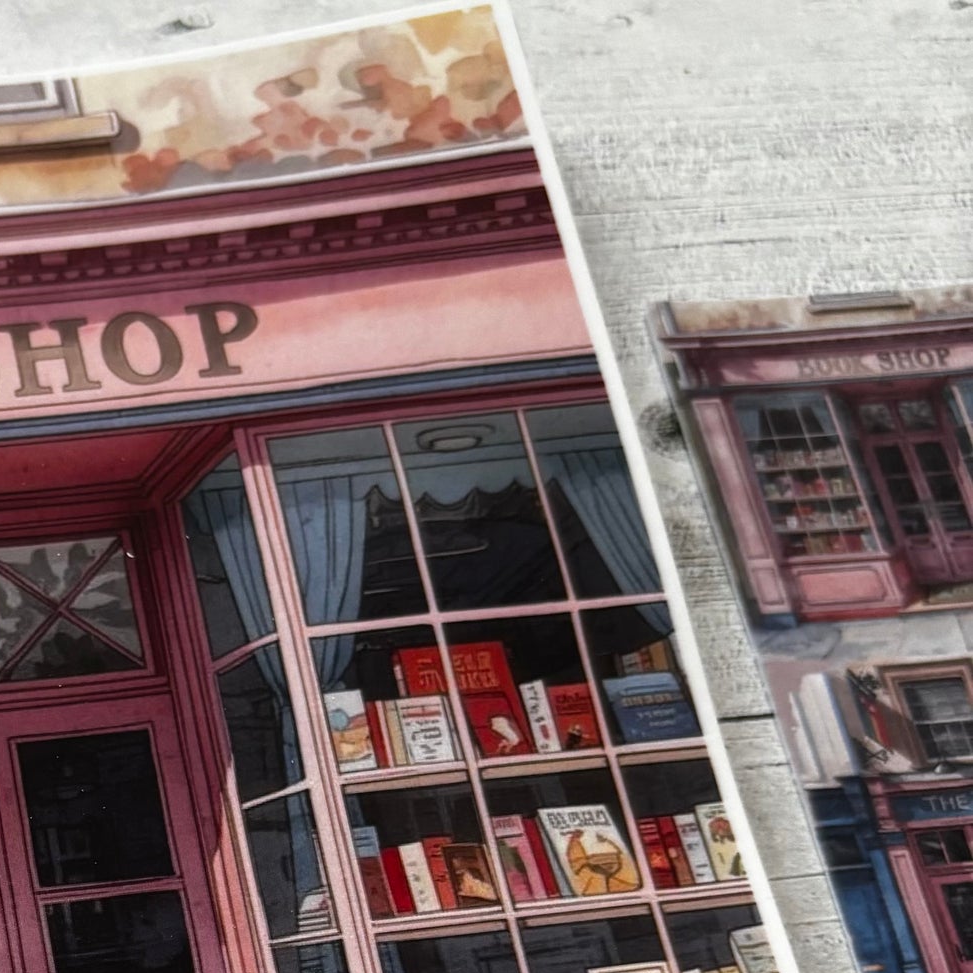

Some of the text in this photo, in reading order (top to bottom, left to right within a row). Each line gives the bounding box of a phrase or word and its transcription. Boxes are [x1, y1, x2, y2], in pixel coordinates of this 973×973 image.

[796, 347, 951, 378] BOOK SHOP
[922, 793, 971, 812] THE
